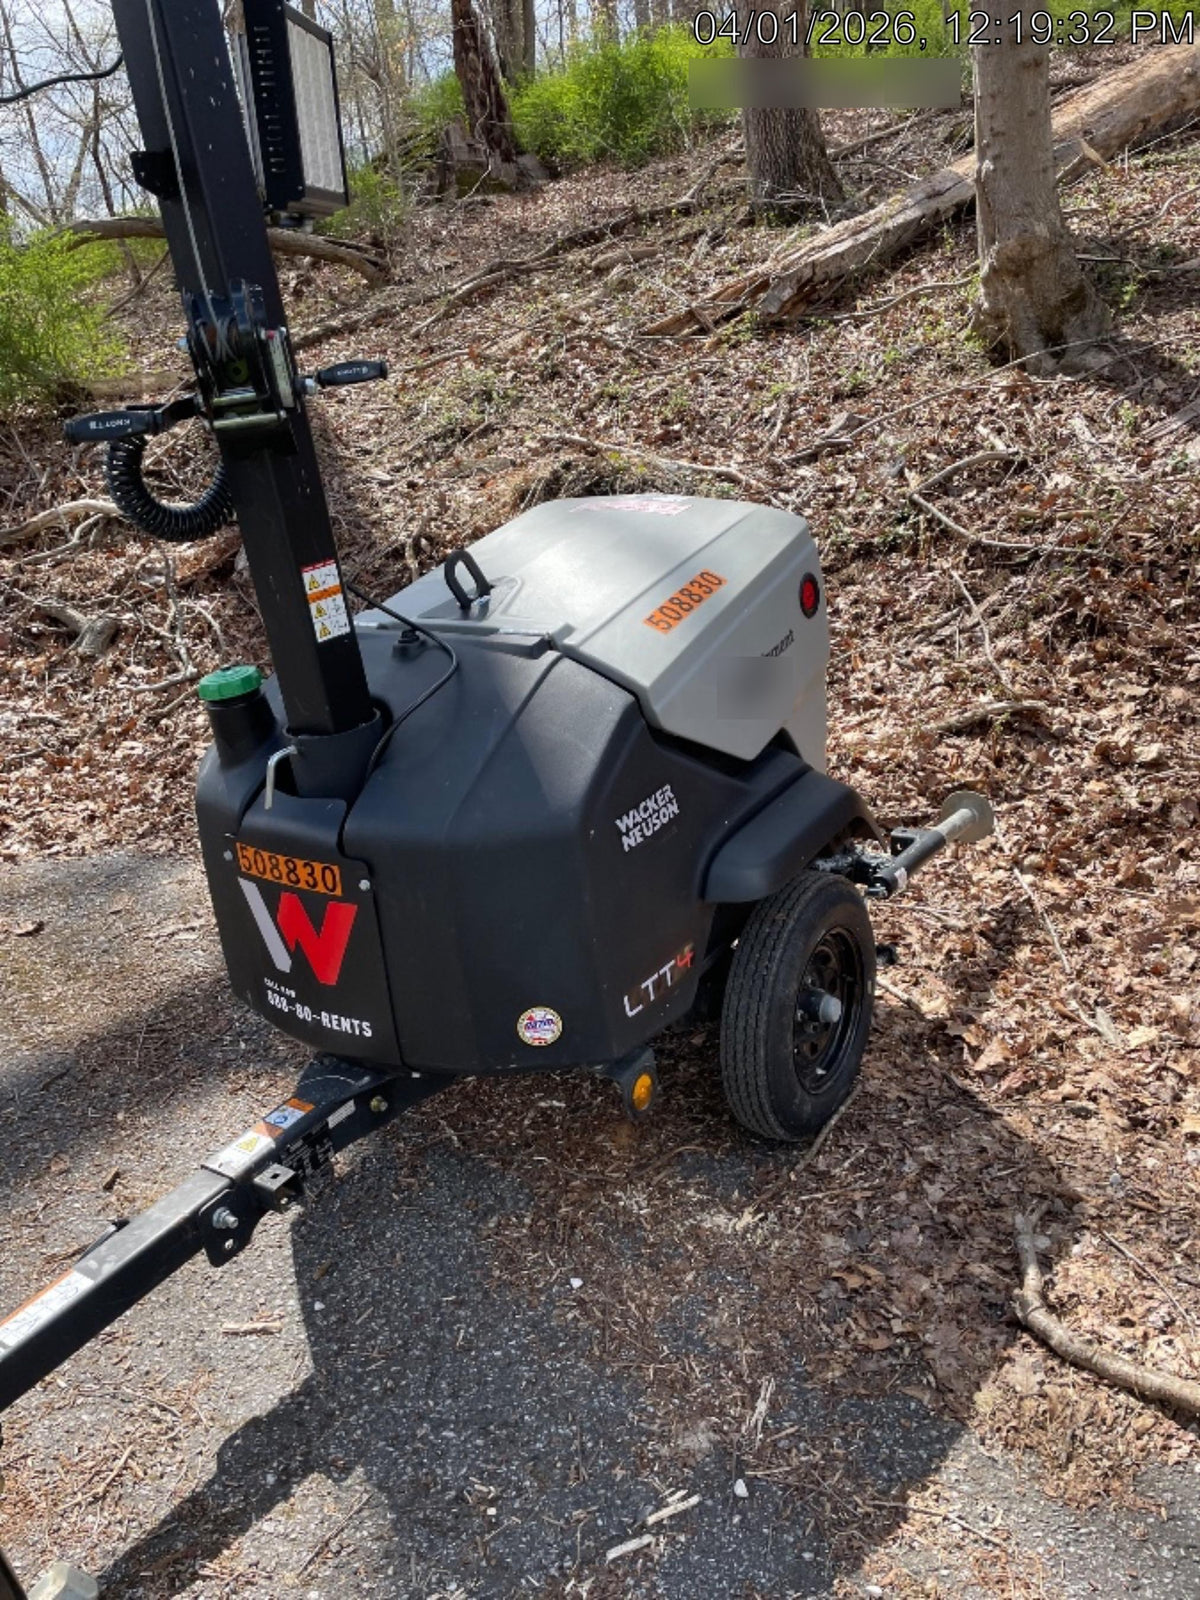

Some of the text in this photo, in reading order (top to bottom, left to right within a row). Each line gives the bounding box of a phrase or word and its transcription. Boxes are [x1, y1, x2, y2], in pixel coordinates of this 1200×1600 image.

[646, 571, 724, 631] 508830
[614, 784, 675, 834] WACKER
[620, 799, 680, 852] NEUSON
[239, 844, 338, 893] 508830
[623, 945, 695, 1018] LTT4
